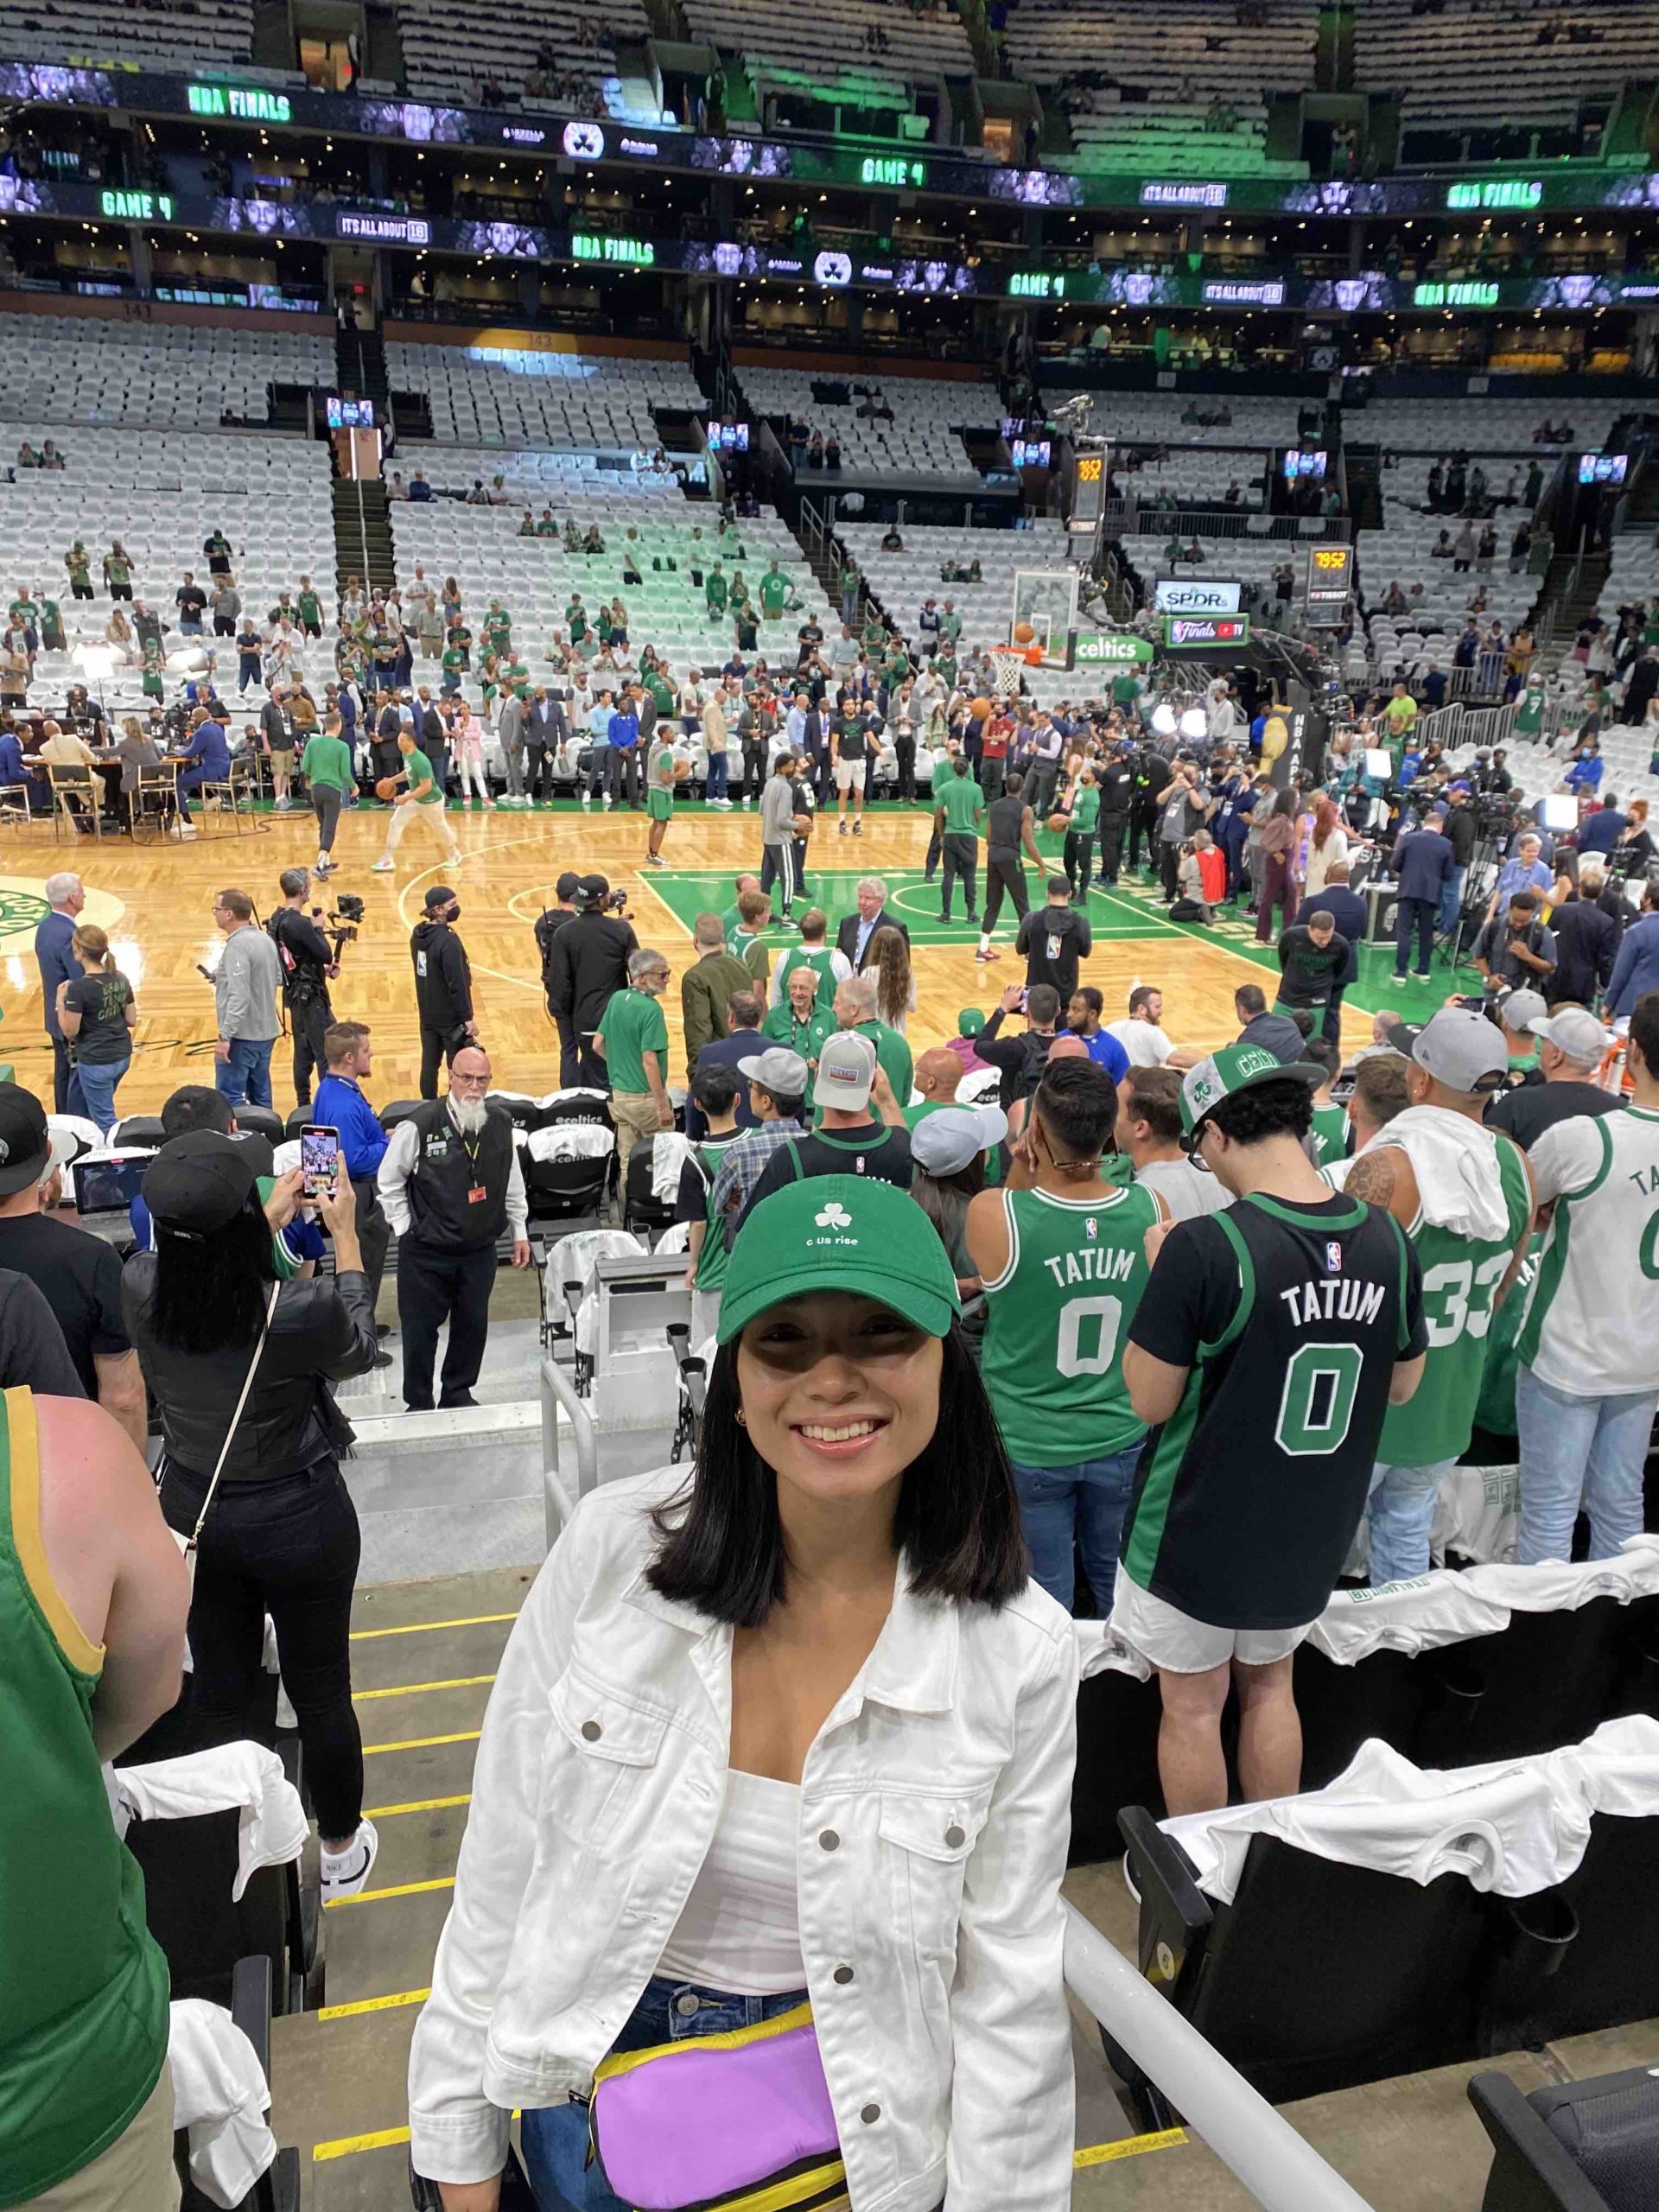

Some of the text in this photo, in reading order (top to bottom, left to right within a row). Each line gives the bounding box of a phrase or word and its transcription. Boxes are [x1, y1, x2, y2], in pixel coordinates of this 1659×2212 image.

[188, 86, 290, 121] NBA FINALS
[863, 158, 906, 185] GAME
[102, 192, 171, 221] GAME 4
[1447, 182, 1542, 207] NBA FINALS
[360, 219, 378, 236] ALL
[378, 220, 407, 238] ABOUT
[572, 235, 654, 264] NBA FINALS
[1010, 275, 1050, 296] GAME
[1414, 283, 1499, 305] NBA FINALS
[1179, 622, 1244, 643] Finals TV
[1076, 635, 1136, 658] celtics
[1292, 715, 1306, 750] NBA
[556, 1115, 602, 1125] @celtics
[817, 1236, 831, 1245] us
[836, 1236, 859, 1245] rise
[1044, 1248, 1136, 1287] TATUM
[1280, 1279, 1385, 1327] TATUM
[1057, 1295, 1122, 1378] 0
[1274, 1343, 1364, 1456] 0
